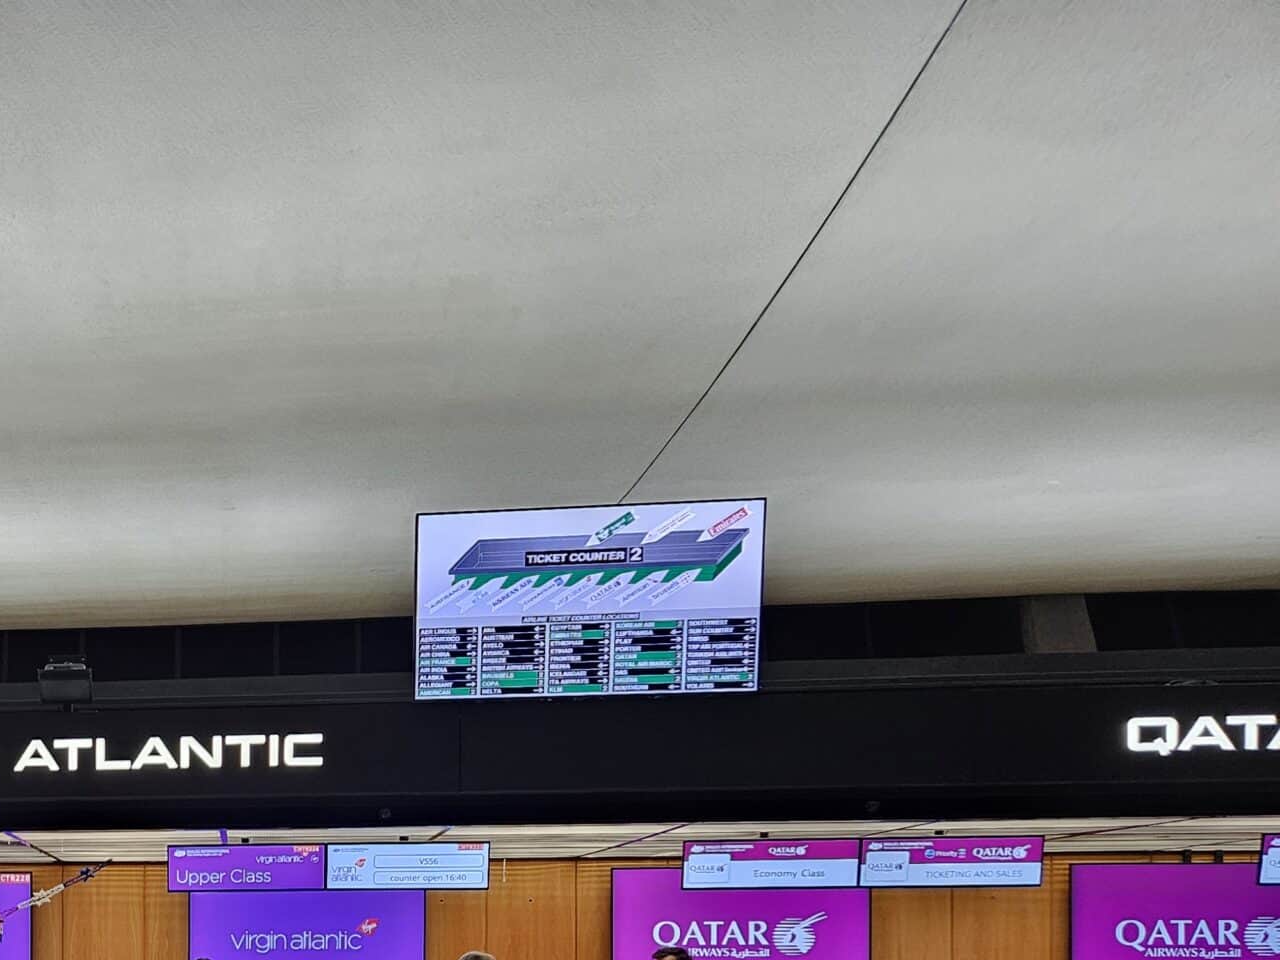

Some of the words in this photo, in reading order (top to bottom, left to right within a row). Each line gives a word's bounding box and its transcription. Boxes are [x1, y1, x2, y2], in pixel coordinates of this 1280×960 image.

[526, 552, 568, 564] TICKET
[568, 550, 625, 562] COUNTER
[630, 547, 642, 561] 2
[1127, 715, 1280, 756] QAT
[13, 733, 324, 772] ATLANTIC
[768, 846, 796, 855] QATAR
[972, 847, 1013, 859] QATAR
[868, 863, 894, 871] QATAR
[176, 869, 226, 886] Upper
[230, 869, 271, 884] Class
[390, 873, 420, 882] counter
[423, 873, 443, 882] open
[445, 873, 467, 882] 16:40
[753, 869, 798, 879] Economy
[801, 868, 825, 878] Class
[926, 870, 970, 879] TICKETING
[973, 870, 994, 878] AND
[996, 869, 1023, 878] SALES
[652, 920, 770, 947] QATAR
[1115, 919, 1241, 952] QATAR
[230, 930, 287, 953] virgin
[290, 930, 362, 950] atlantic
[688, 947, 730, 957] IRWAYS
[1144, 947, 1198, 958] AIRWAYS
